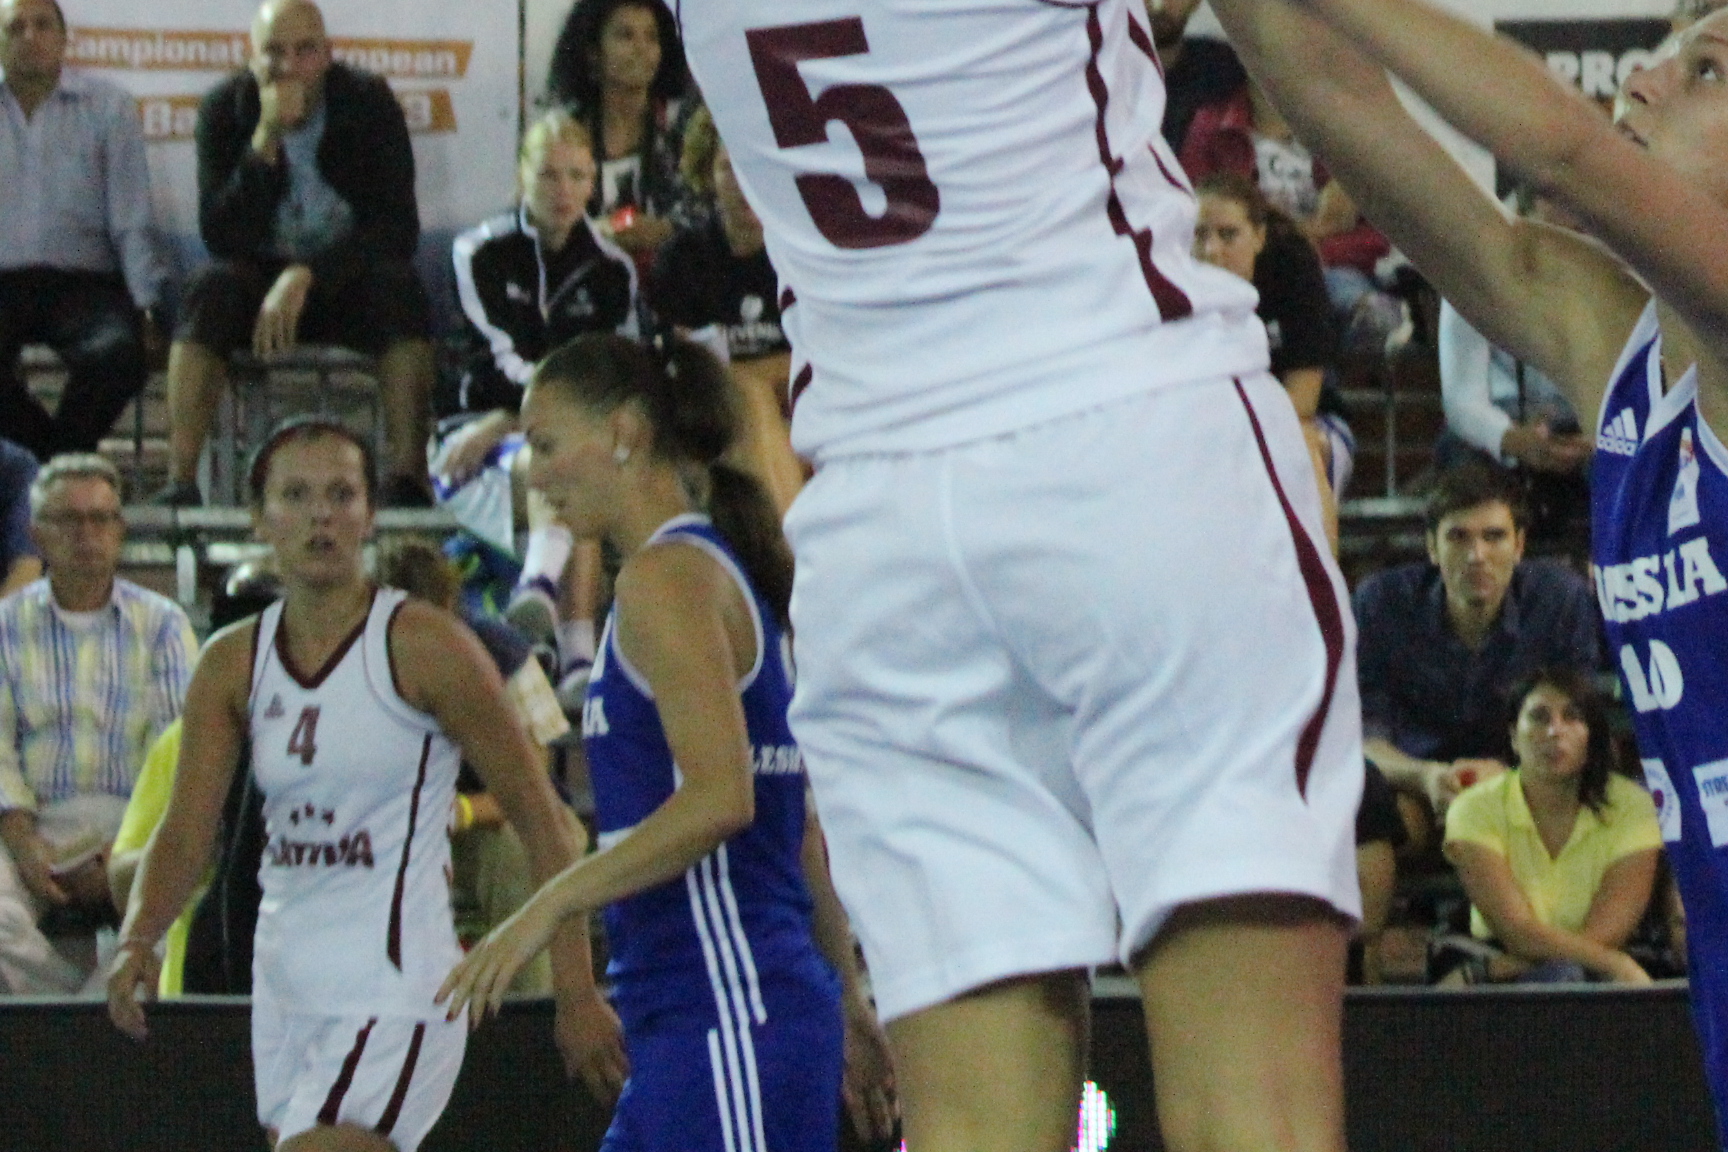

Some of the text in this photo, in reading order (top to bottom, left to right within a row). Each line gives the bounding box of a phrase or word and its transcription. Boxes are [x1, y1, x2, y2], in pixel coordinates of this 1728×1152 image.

[744, 15, 941, 249] 5
[1594, 536, 1728, 624] USSIA
[1620, 639, 1684, 713] 10
[287, 705, 321, 765] 4
